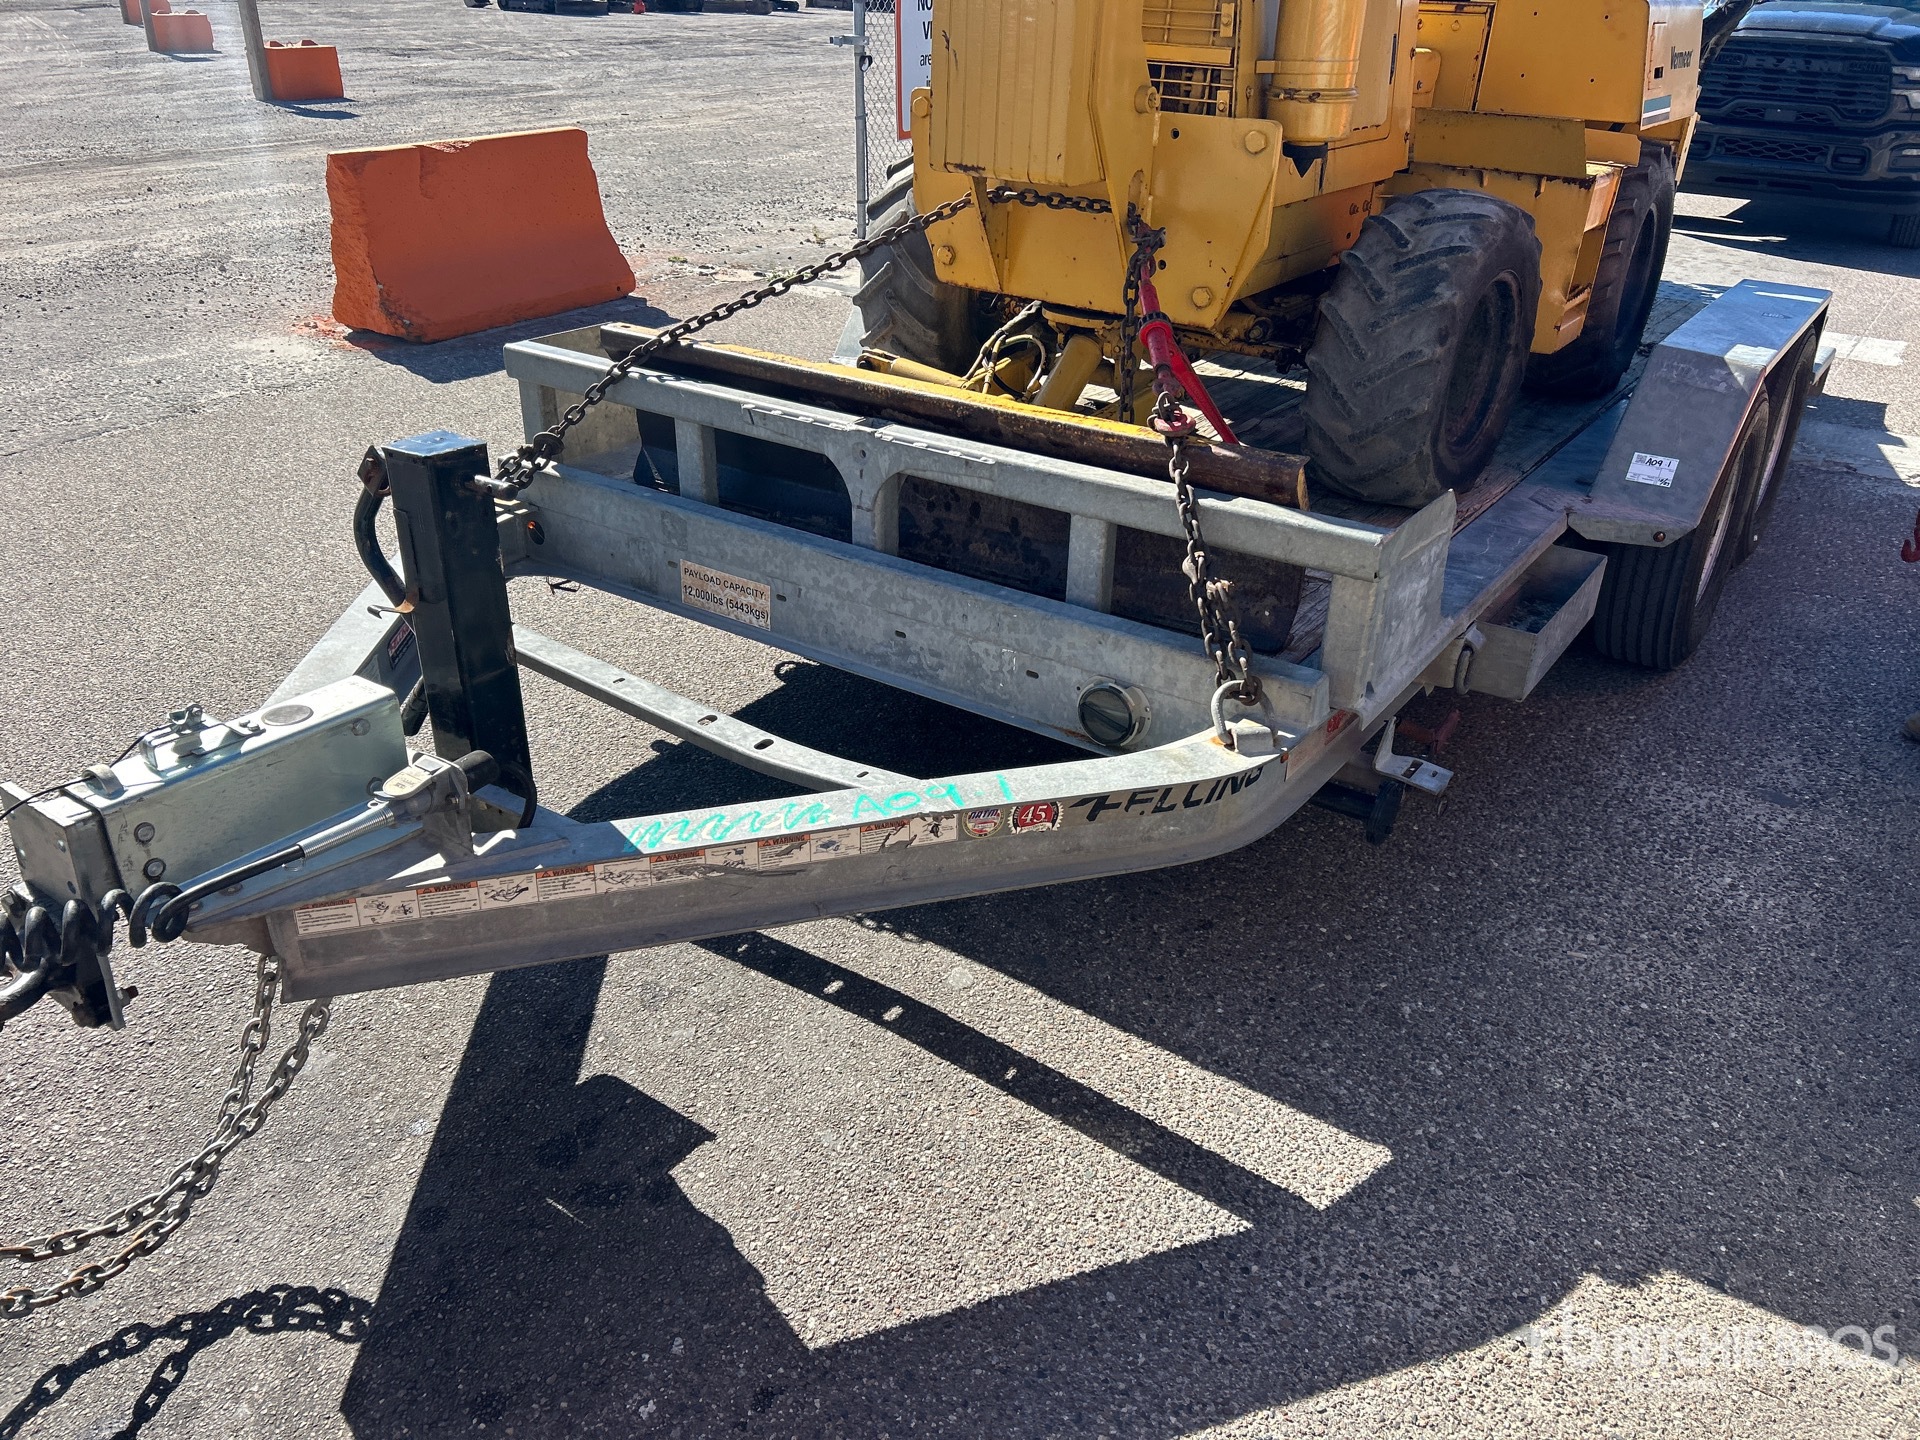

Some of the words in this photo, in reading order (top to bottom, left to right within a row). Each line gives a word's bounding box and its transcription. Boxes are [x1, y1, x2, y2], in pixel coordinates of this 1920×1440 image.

[1670, 46, 1693, 70] Vermeer
[684, 567, 721, 586] PAYLOAD
[723, 580, 765, 599] CAPACITY
[683, 584, 724, 606] 12,000lbs
[725, 598, 769, 623] (5443kgs)
[1021, 805, 1048, 823] 45
[874, 820, 906, 830] WARNING
[772, 835, 805, 845] WARNING
[665, 850, 700, 861] WARNING
[552, 866, 588, 876] WARNING
[434, 882, 472, 893] WARNING
